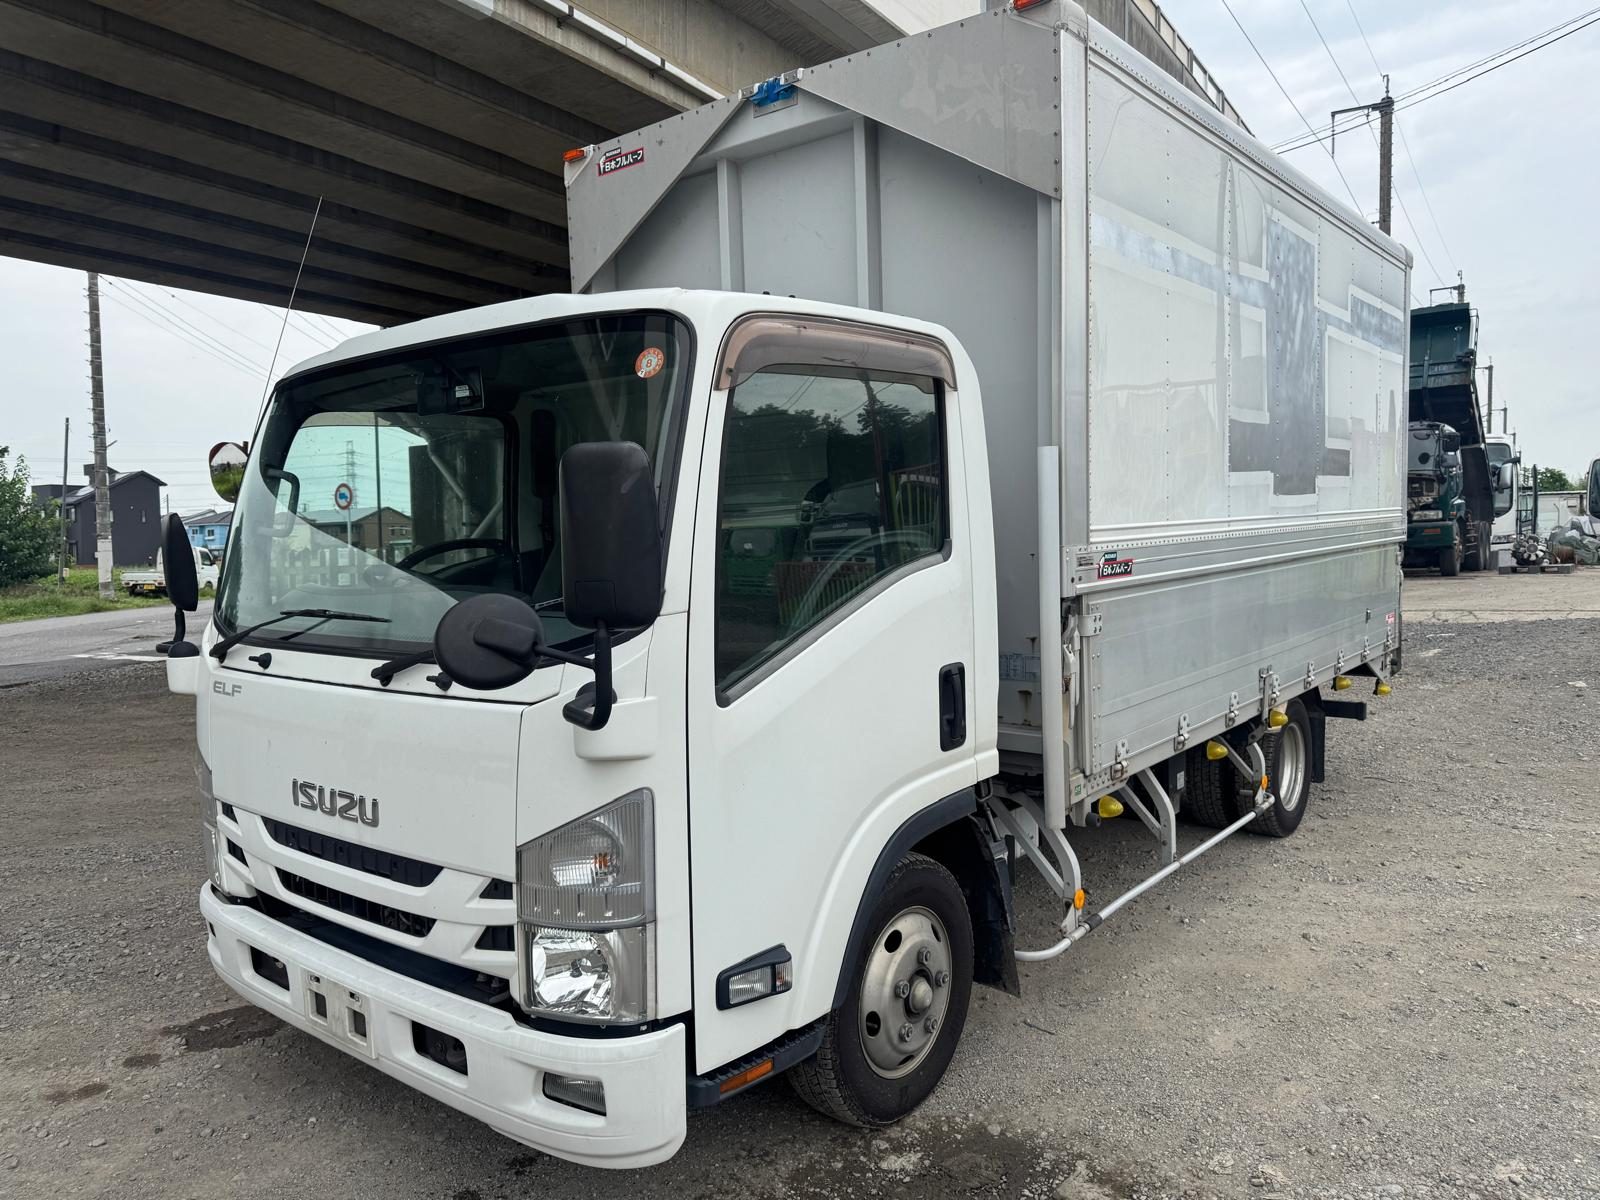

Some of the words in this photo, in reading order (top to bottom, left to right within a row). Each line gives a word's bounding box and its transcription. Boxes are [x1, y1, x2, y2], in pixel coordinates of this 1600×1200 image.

[605, 150, 643, 172] 日本フルハーフ
[213, 680, 242, 697] ELF
[291, 778, 380, 828] ISUZU
